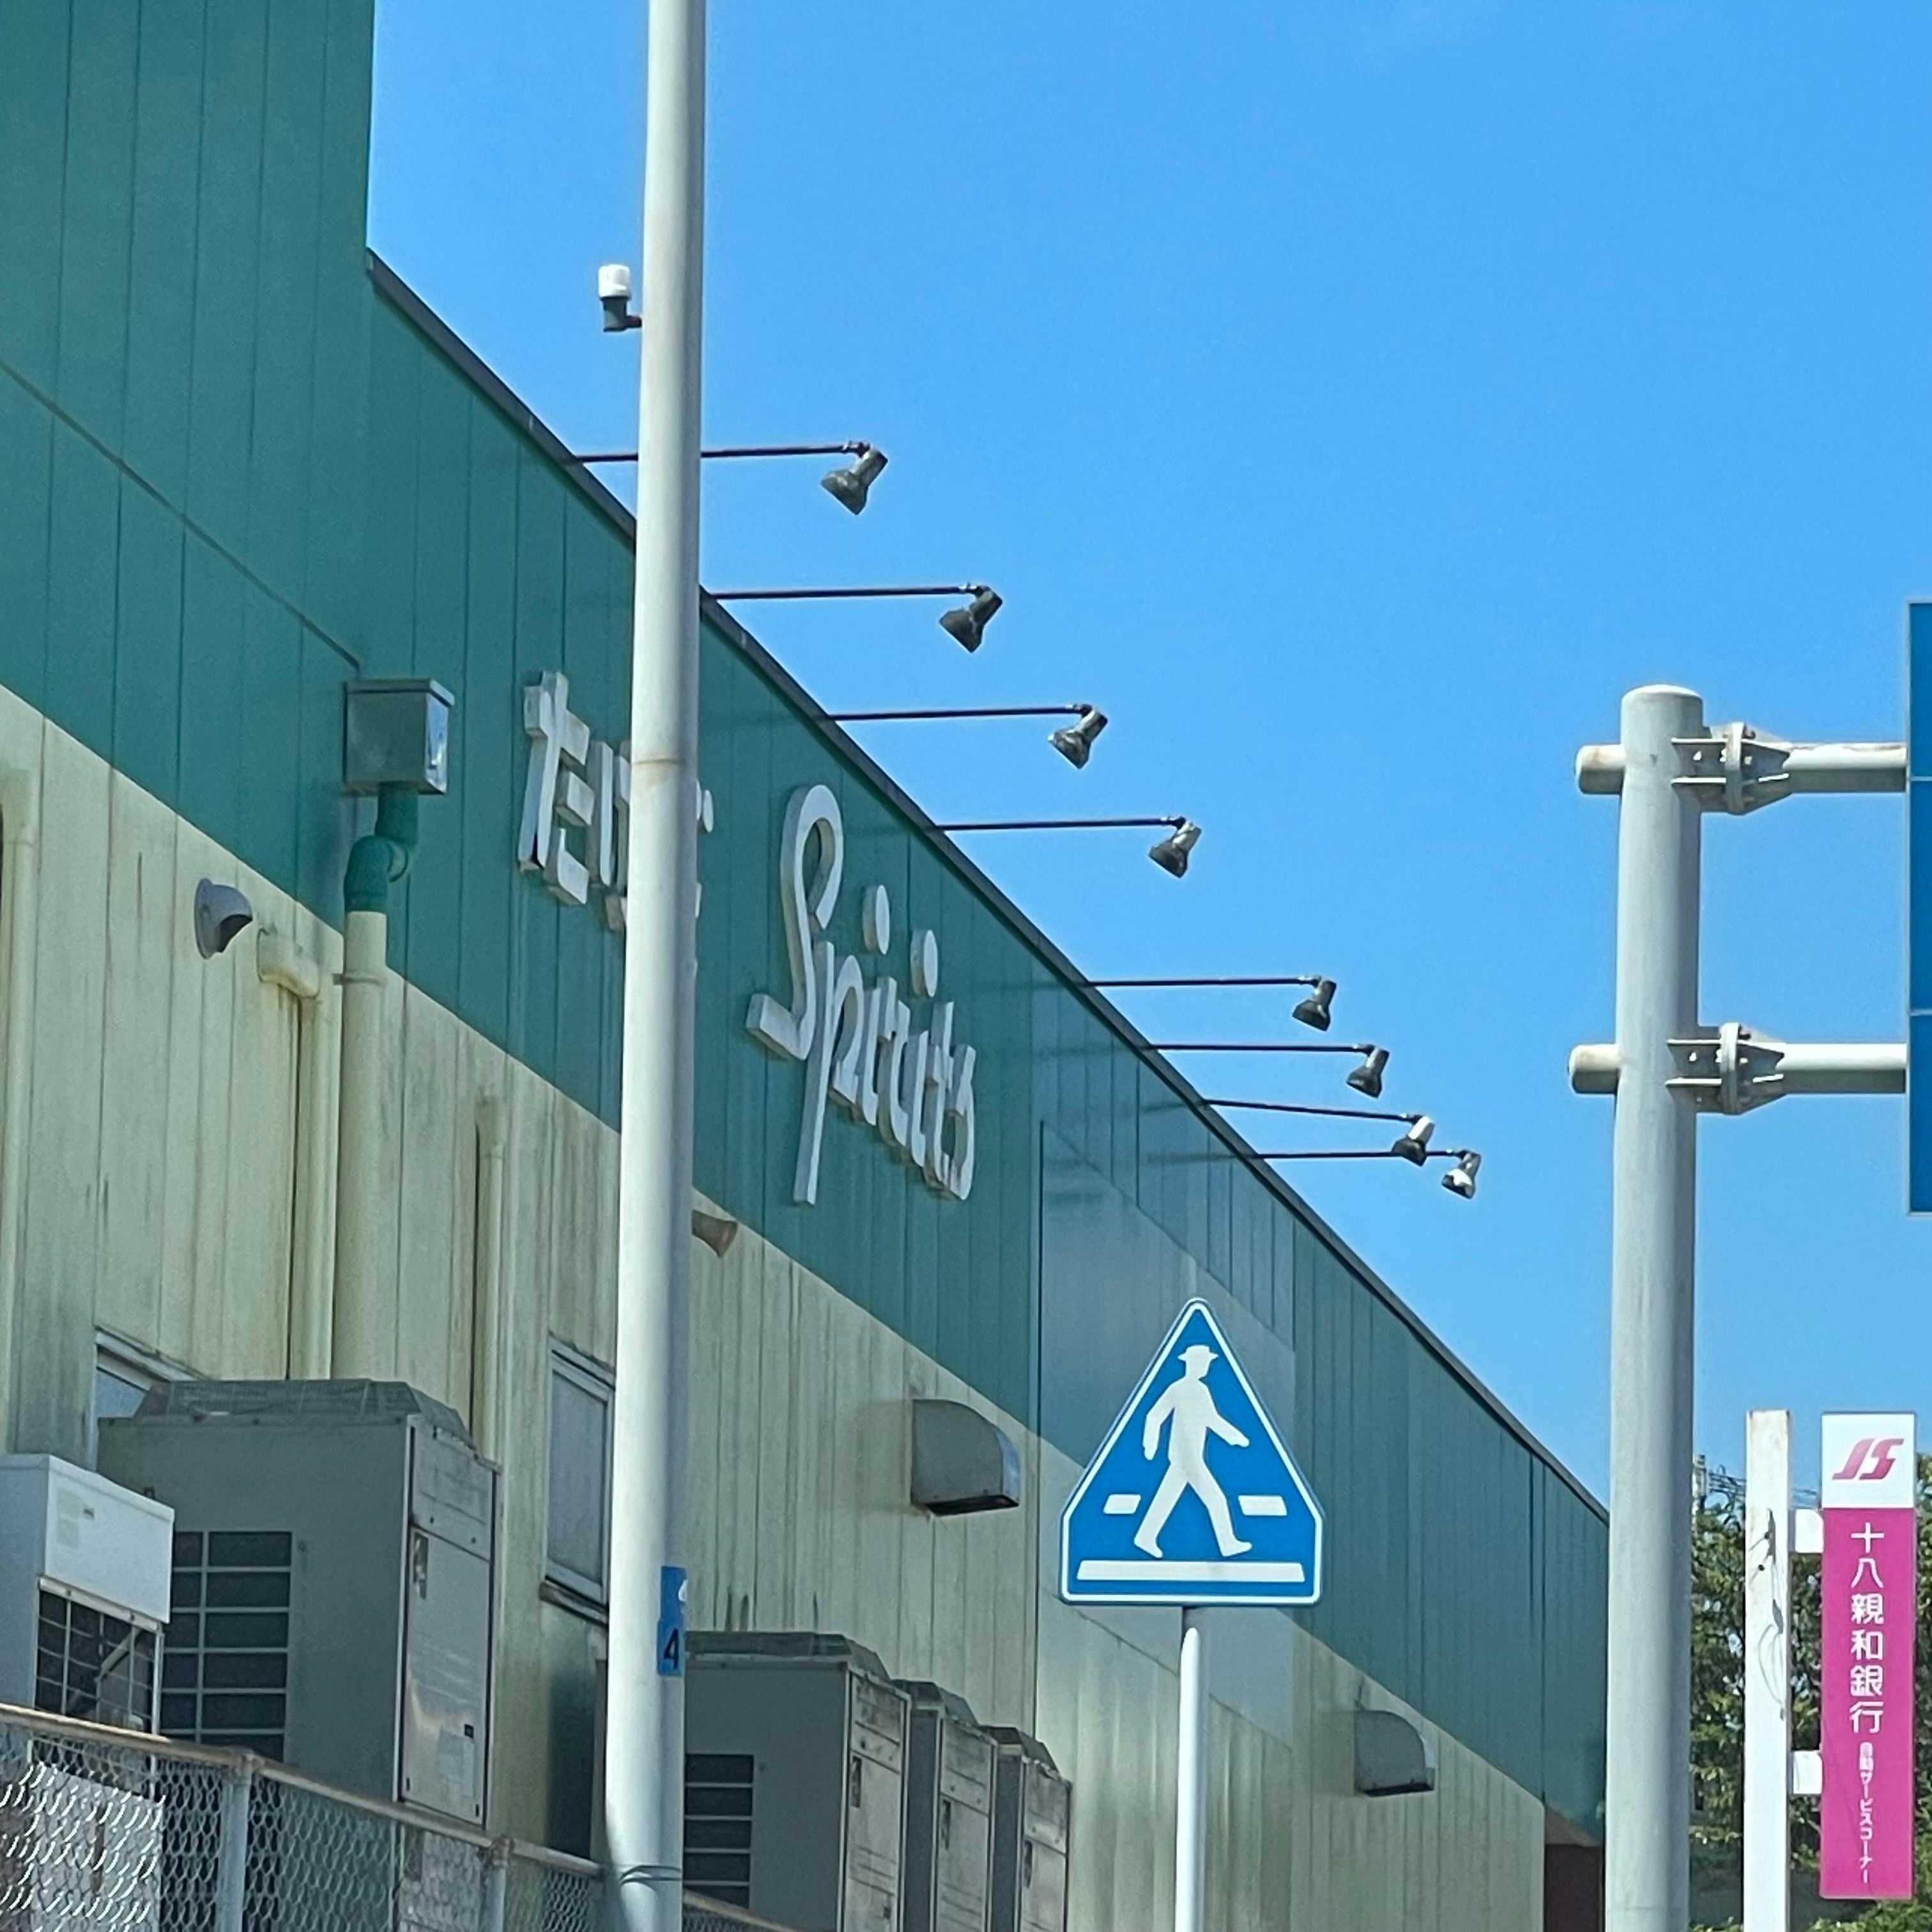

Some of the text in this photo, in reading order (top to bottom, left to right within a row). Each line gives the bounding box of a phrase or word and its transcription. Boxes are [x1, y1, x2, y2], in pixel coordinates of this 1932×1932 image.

[747, 784, 976, 1206] Spirits
[1850, 1522, 1885, 1733] 十八親和銀行
